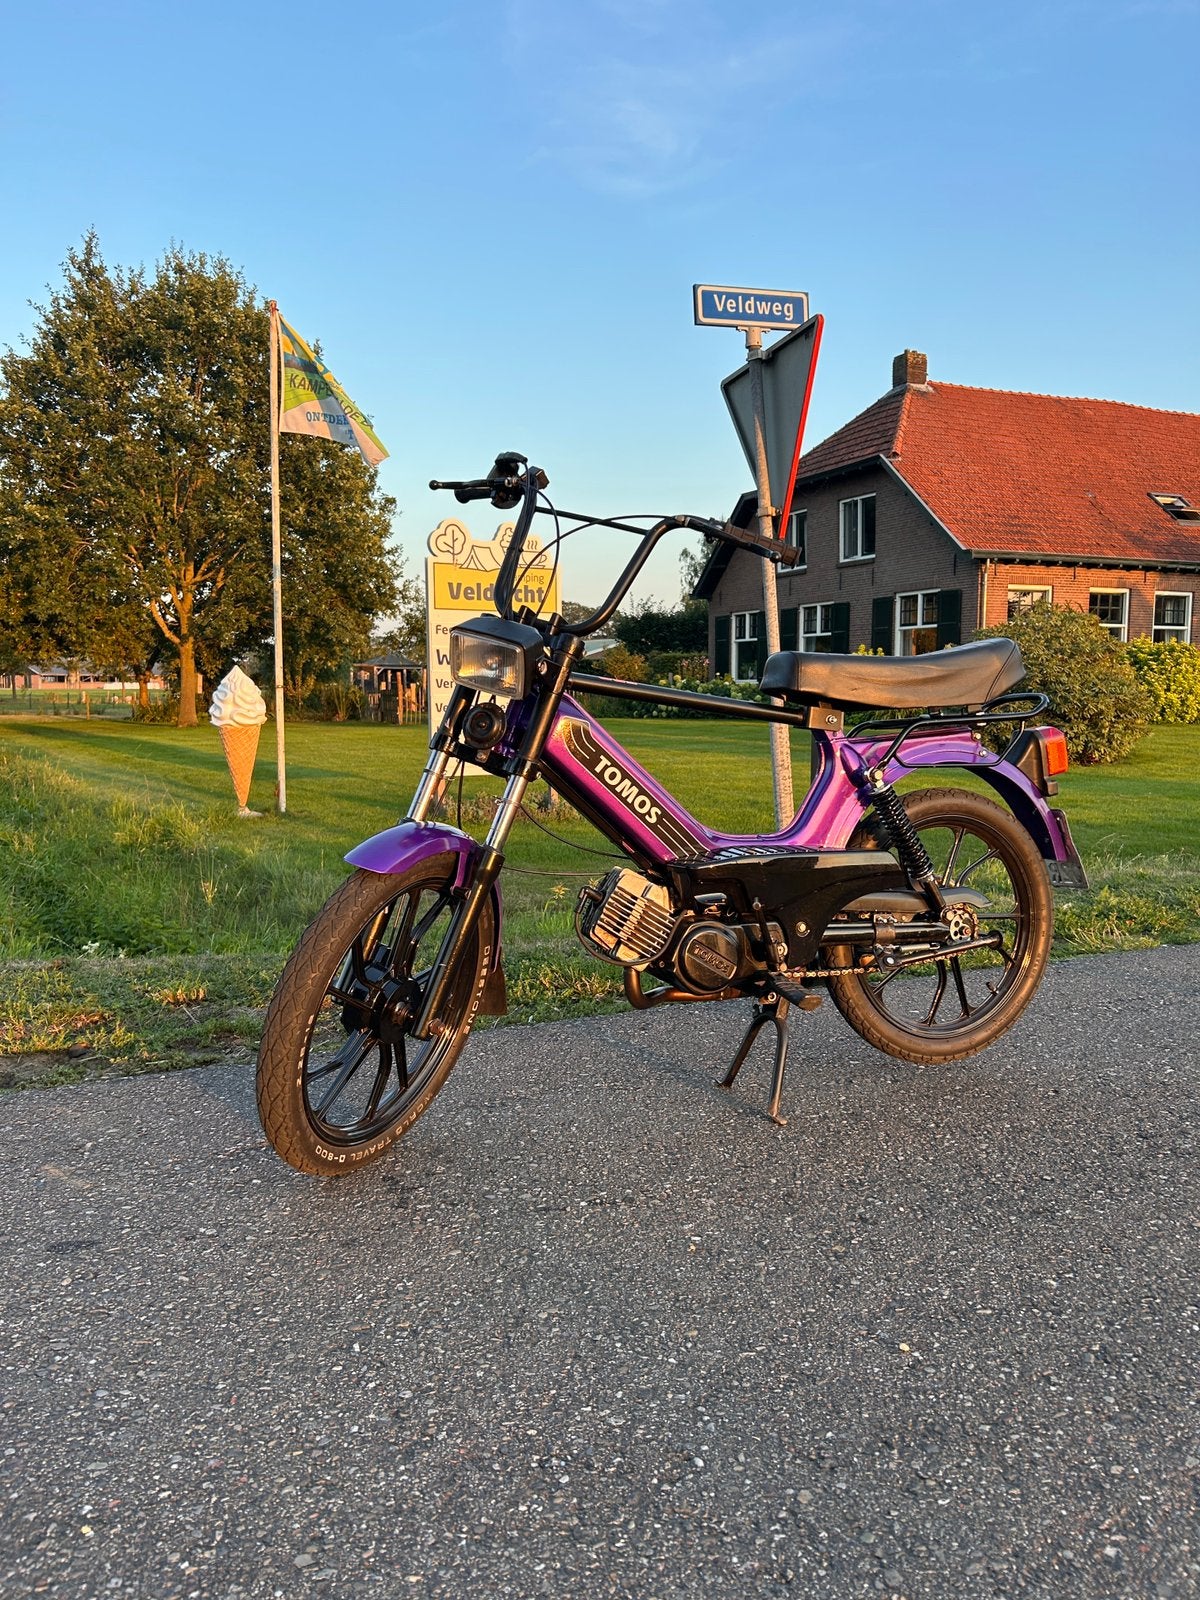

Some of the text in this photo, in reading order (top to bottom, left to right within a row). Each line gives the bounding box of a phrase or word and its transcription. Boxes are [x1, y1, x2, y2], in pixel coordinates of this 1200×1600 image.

[713, 293, 794, 321] Veldweg
[448, 582, 545, 603] Veldcht
[594, 754, 663, 824] TOMOS
[350, 1136, 392, 1162] TRAVEL
